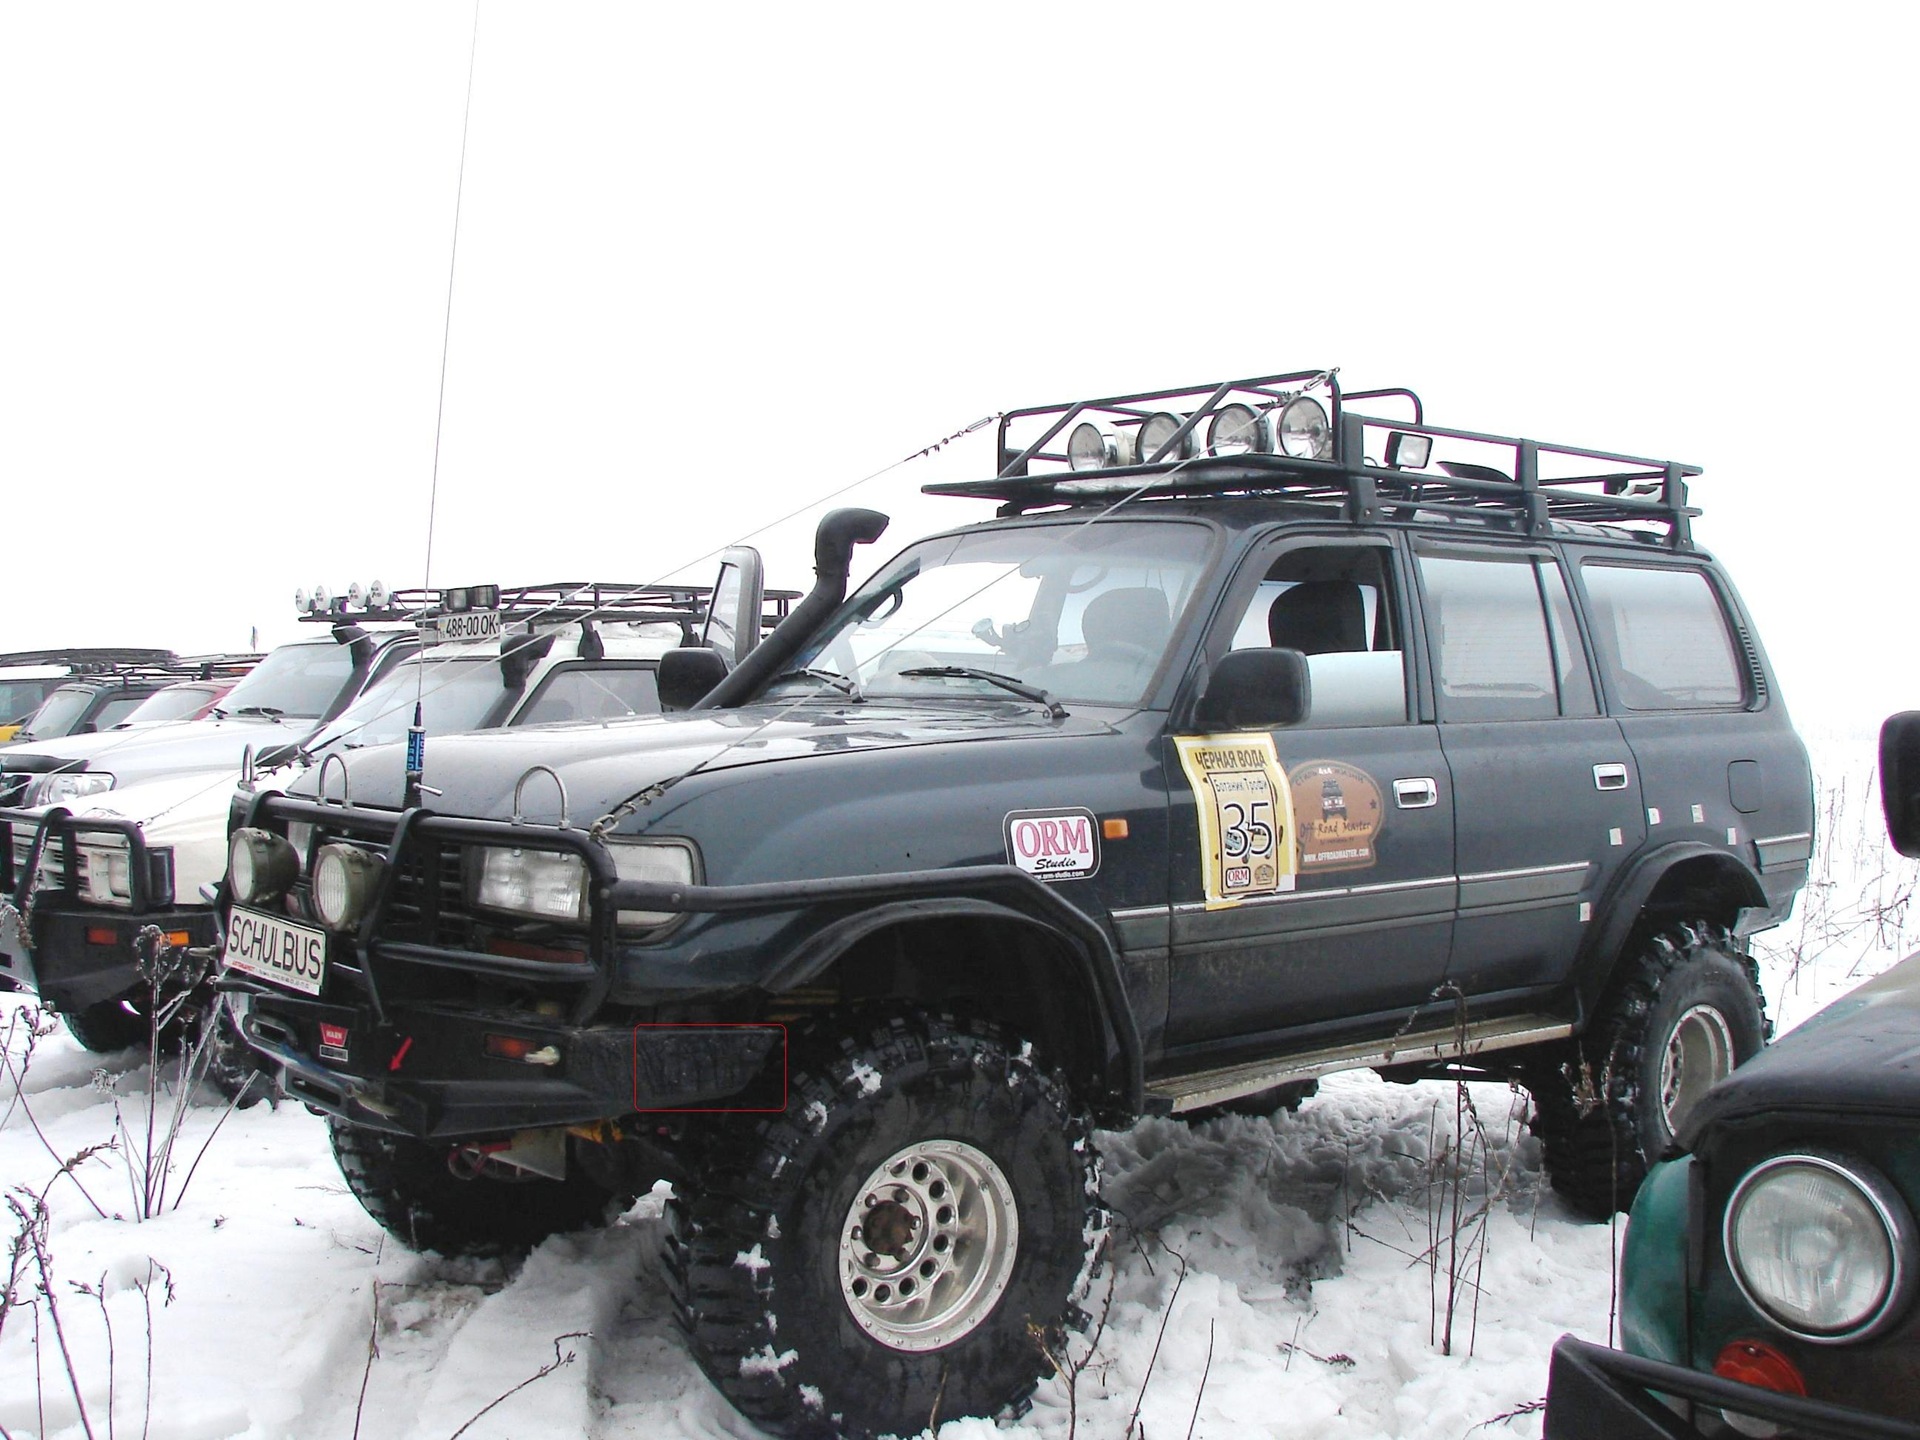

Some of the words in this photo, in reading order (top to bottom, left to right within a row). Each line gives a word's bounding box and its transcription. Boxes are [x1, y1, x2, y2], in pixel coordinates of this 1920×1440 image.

[446, 616, 480, 638] 488-00
[1237, 749, 1267, 768] ВОДА
[1016, 819, 1089, 858] ORM
[1223, 802, 1273, 857] 35
[1034, 857, 1077, 870] Studio
[1228, 869, 1248, 882] ORM
[229, 914, 321, 980] SCHULBUS
